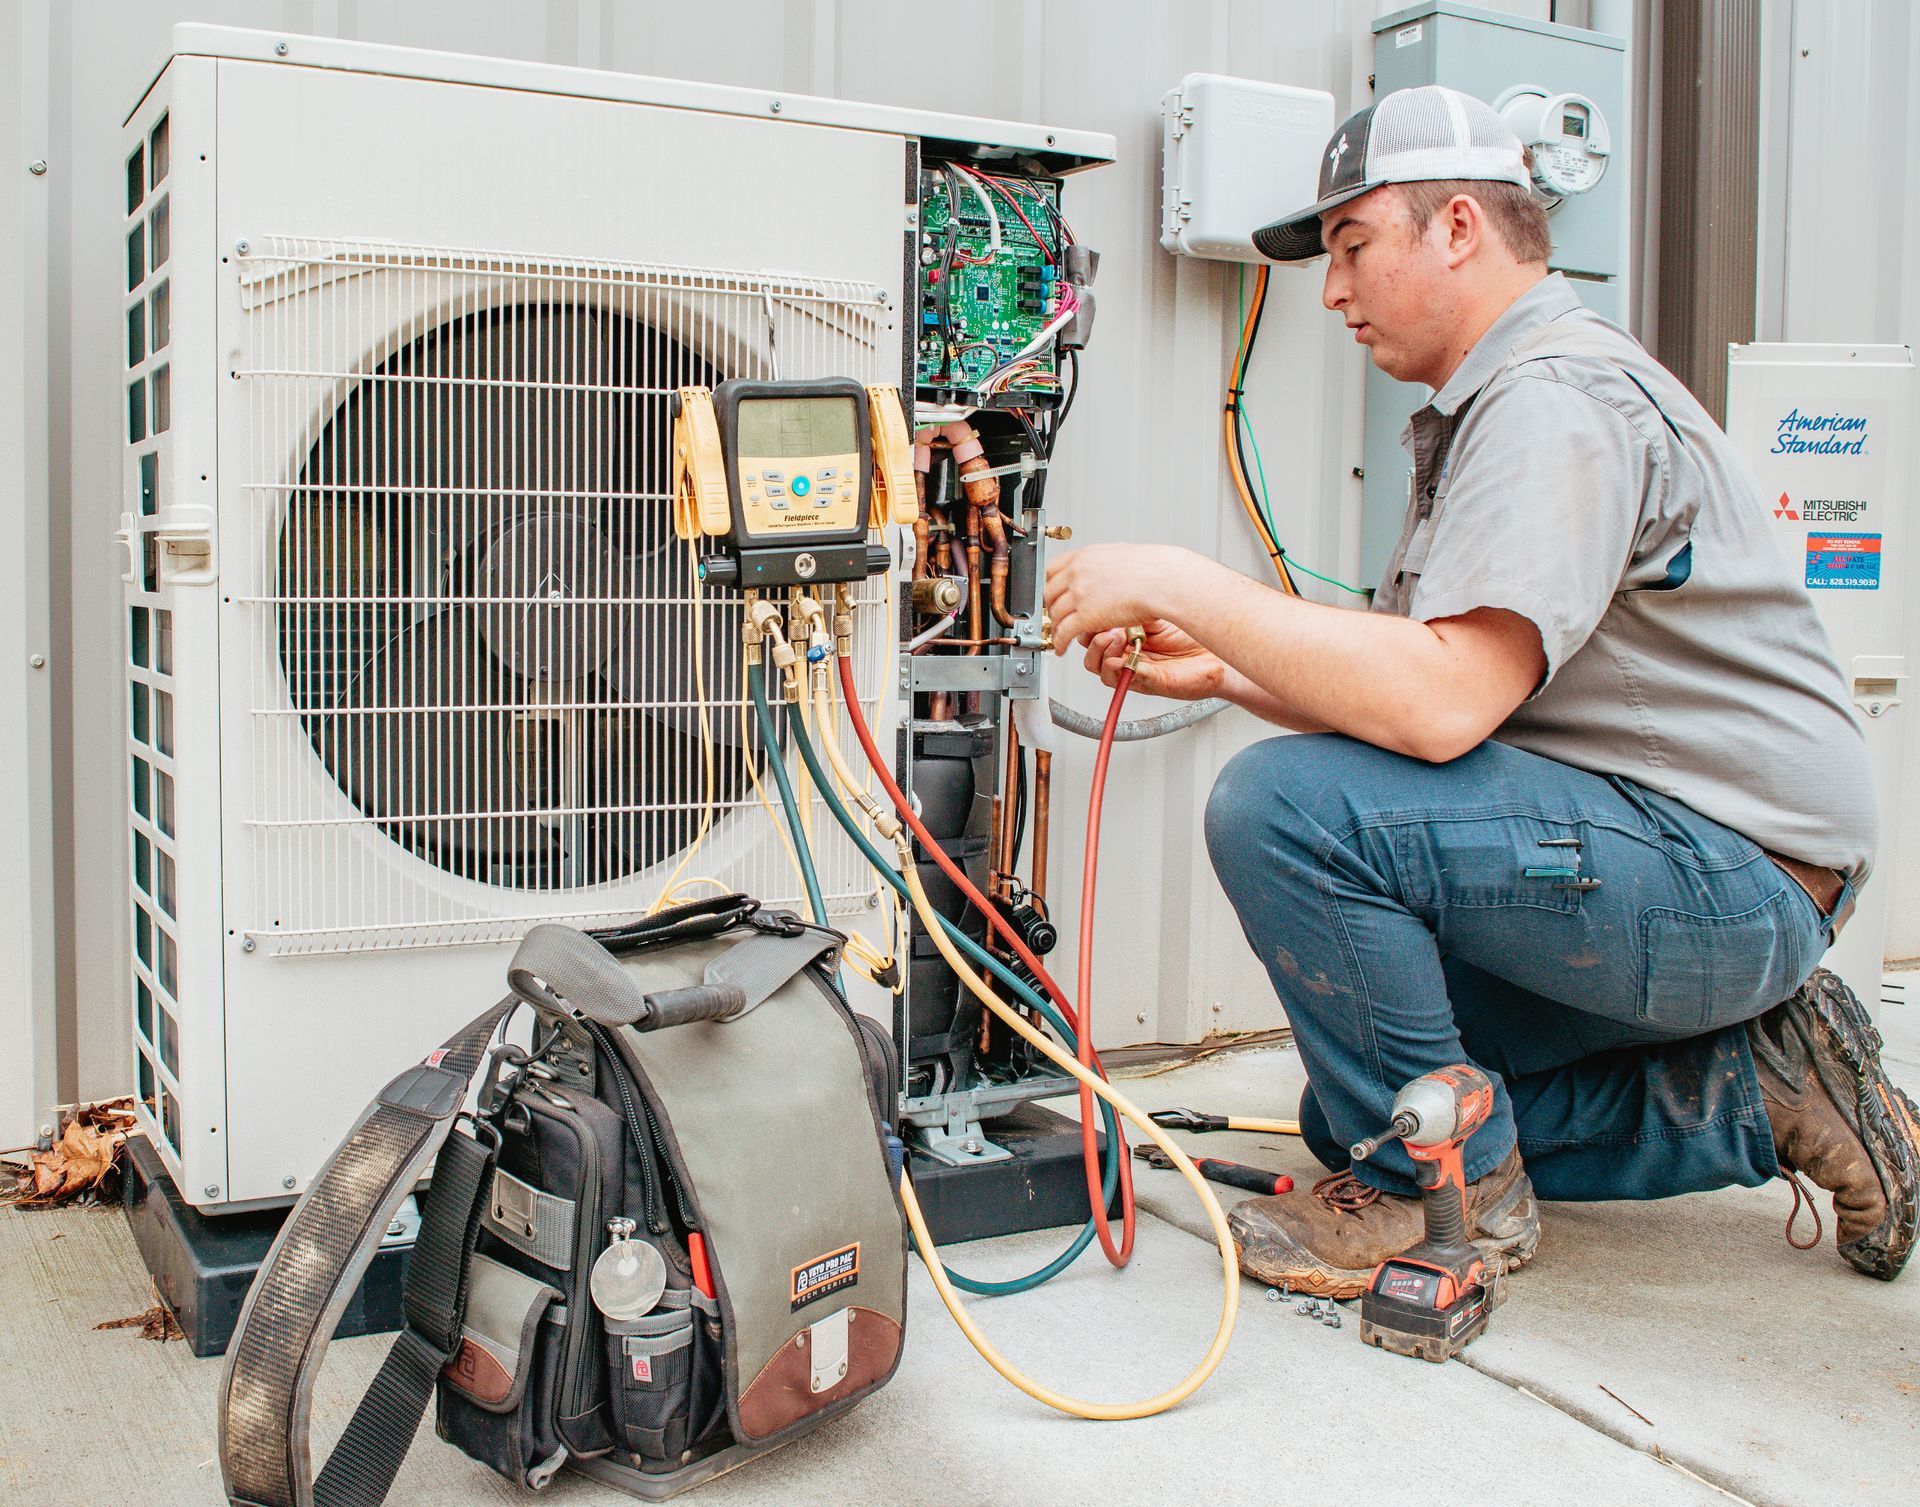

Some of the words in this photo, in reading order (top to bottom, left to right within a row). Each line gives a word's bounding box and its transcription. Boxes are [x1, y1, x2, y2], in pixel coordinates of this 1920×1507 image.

[1777, 408, 1867, 432] American
[1770, 433, 1868, 455] Standard
[1803, 500, 1867, 511] MITSUBISHI
[784, 514, 819, 522] Fieldpiece
[1803, 511, 1858, 521] ELECTRIC
[1807, 577, 1827, 585] CALL:
[1829, 578, 1877, 586] 828.519.9030
[808, 1262, 824, 1278] VETO
[825, 1257, 839, 1271] PRO
[840, 1265, 852, 1274] WORK
[797, 1290, 818, 1304] TECH
[821, 1275, 854, 1292] SERIES
